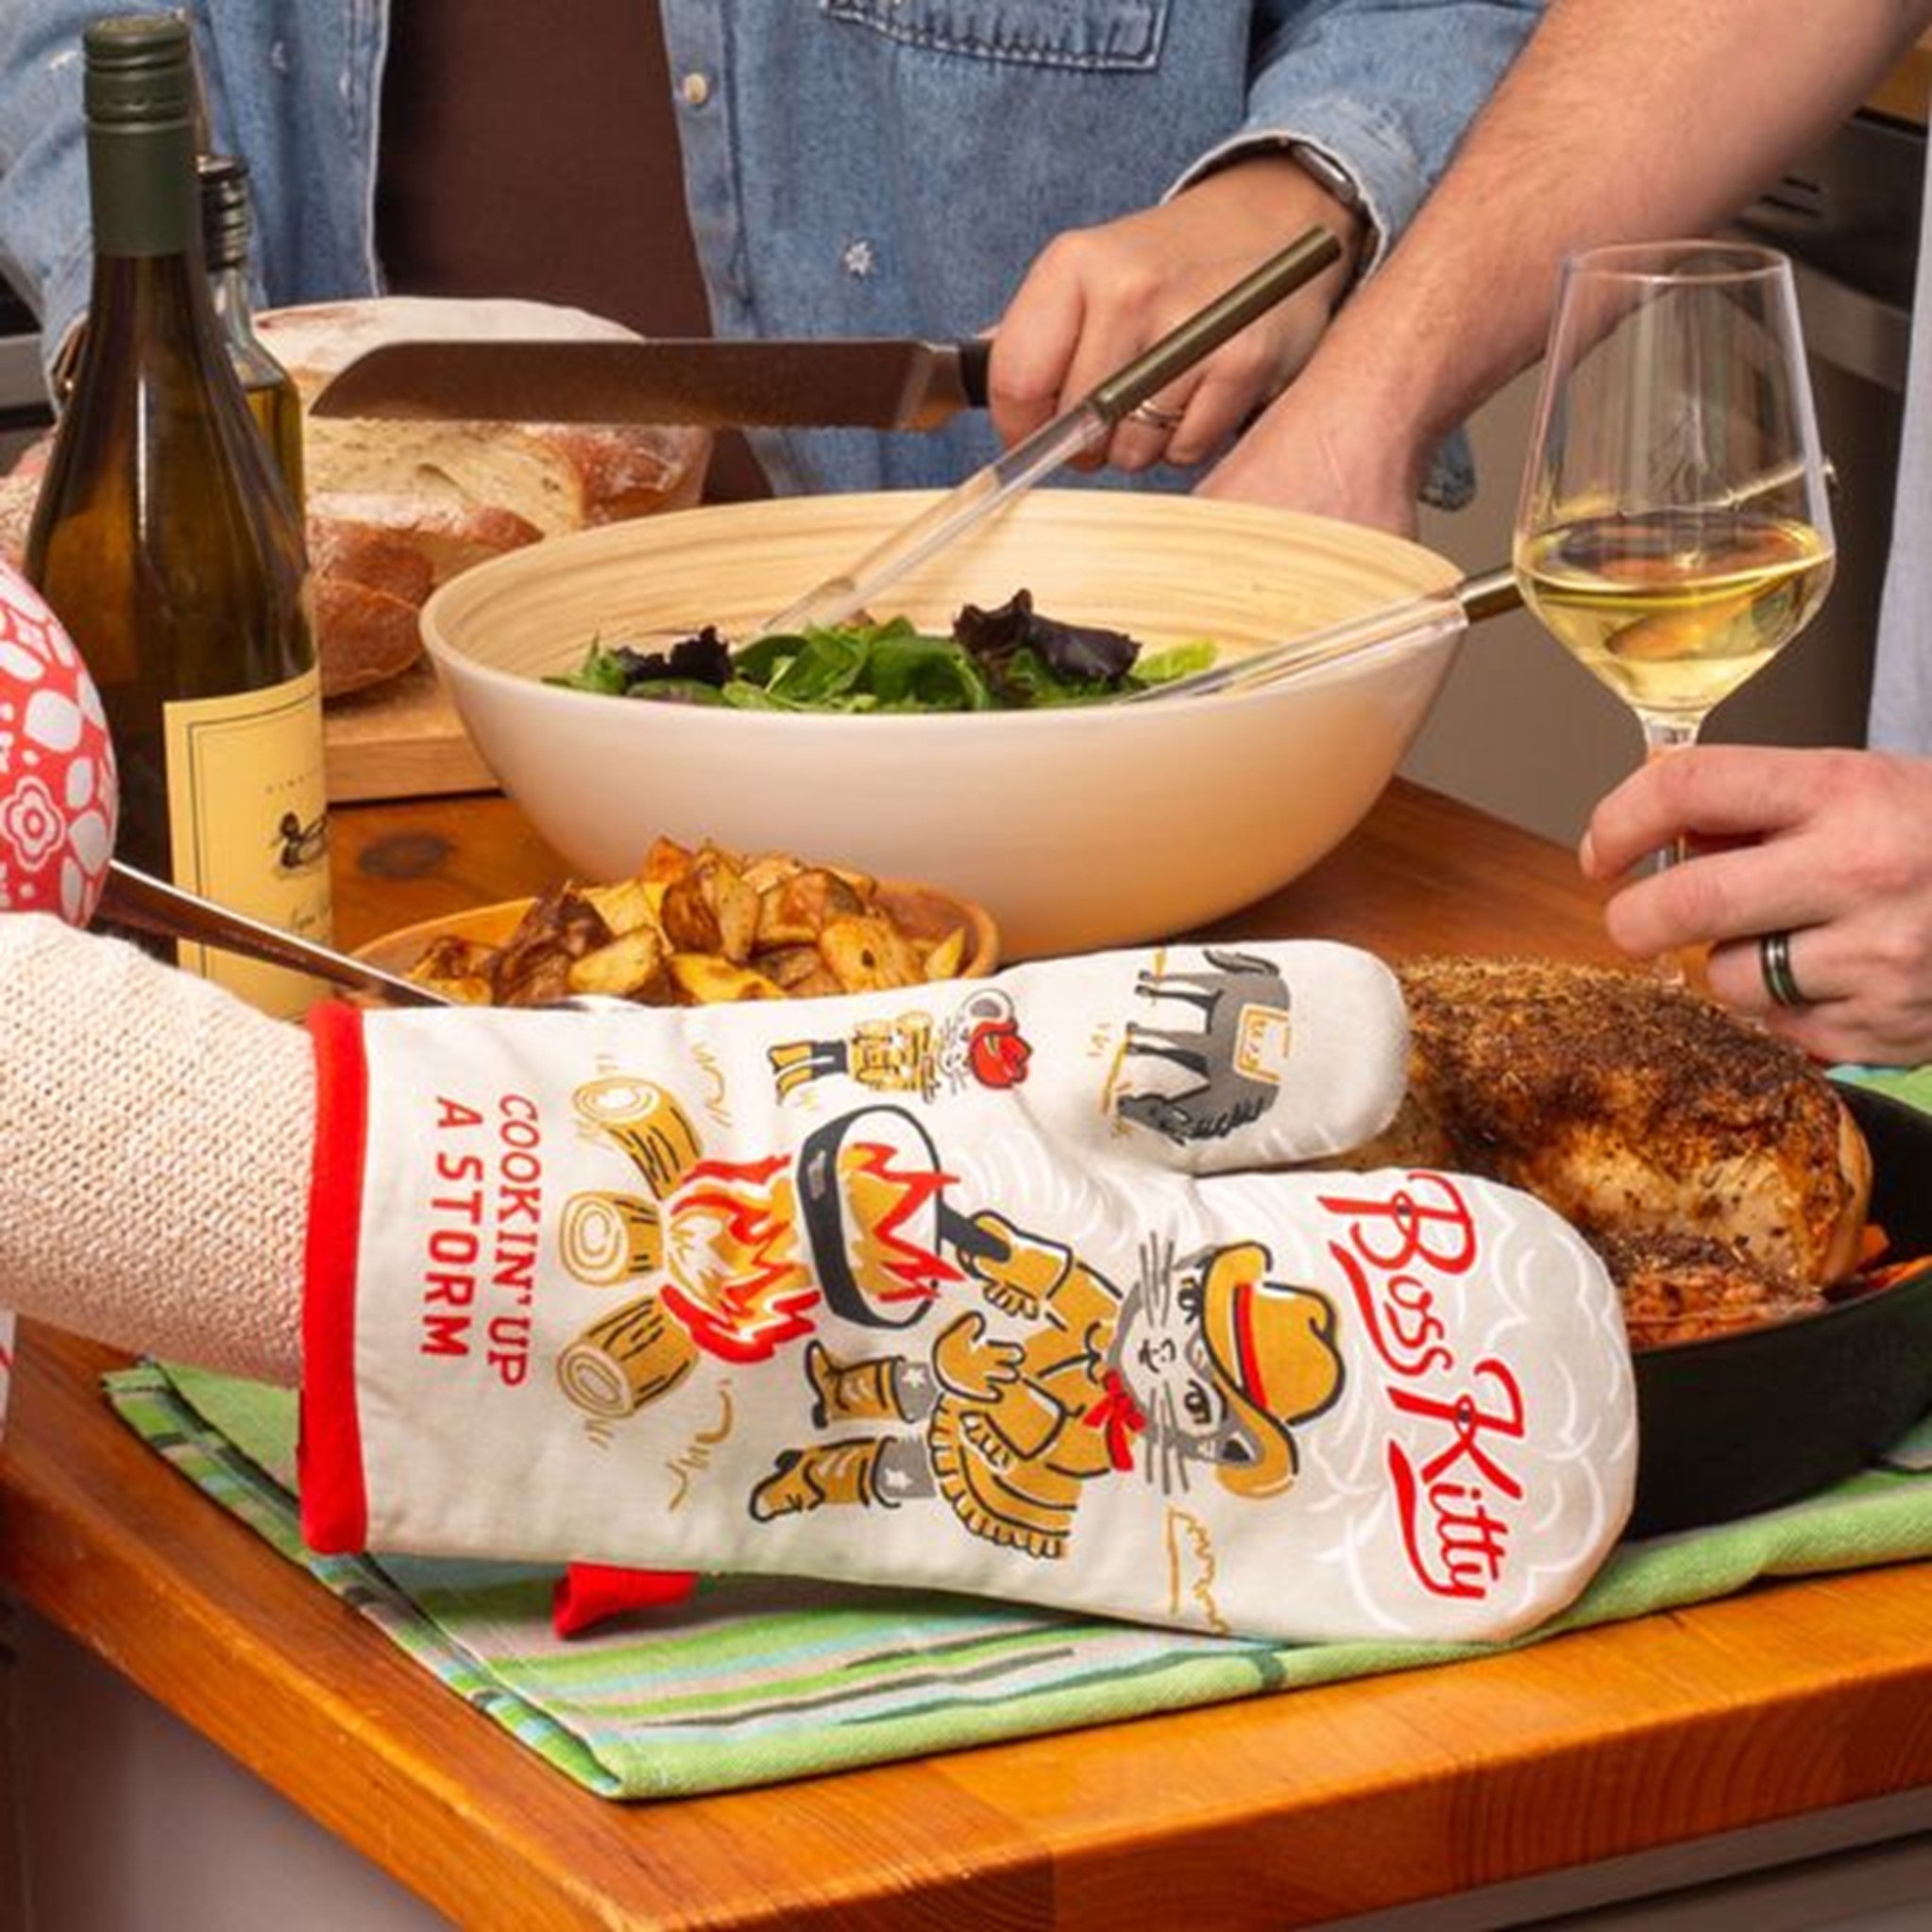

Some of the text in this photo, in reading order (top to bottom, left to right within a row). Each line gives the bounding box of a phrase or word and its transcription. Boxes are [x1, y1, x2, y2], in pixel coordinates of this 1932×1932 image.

[420, 1095, 484, 1358] A STORM
[485, 1093, 542, 1387] COOKIN' UP
[1316, 1169, 1526, 1601] Boss Kitty
